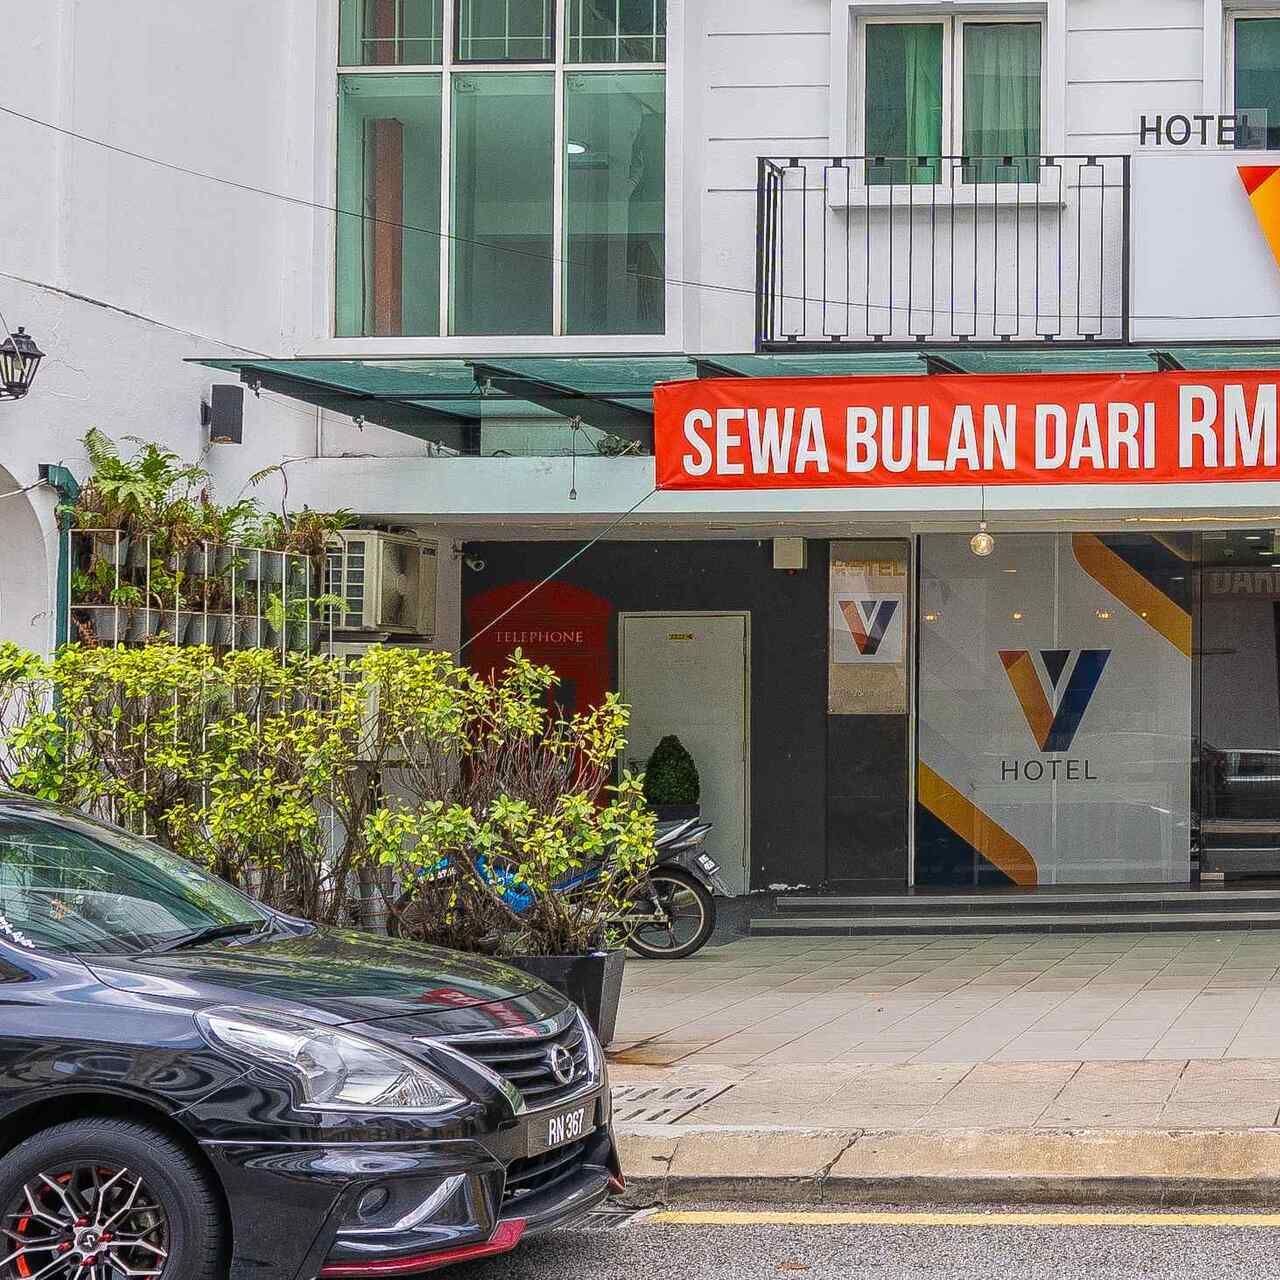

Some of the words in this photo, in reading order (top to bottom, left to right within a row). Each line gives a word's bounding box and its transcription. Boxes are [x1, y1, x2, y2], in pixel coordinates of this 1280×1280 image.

[682, 407, 830, 476] SEWA
[846, 404, 1017, 474] BULAN
[1034, 402, 1155, 470] DARI
[496, 630, 585, 644] TELEPHONE
[1001, 759, 1098, 781] HOTEL
[548, 1114, 565, 1146] RN
[566, 1107, 585, 1139] 367
